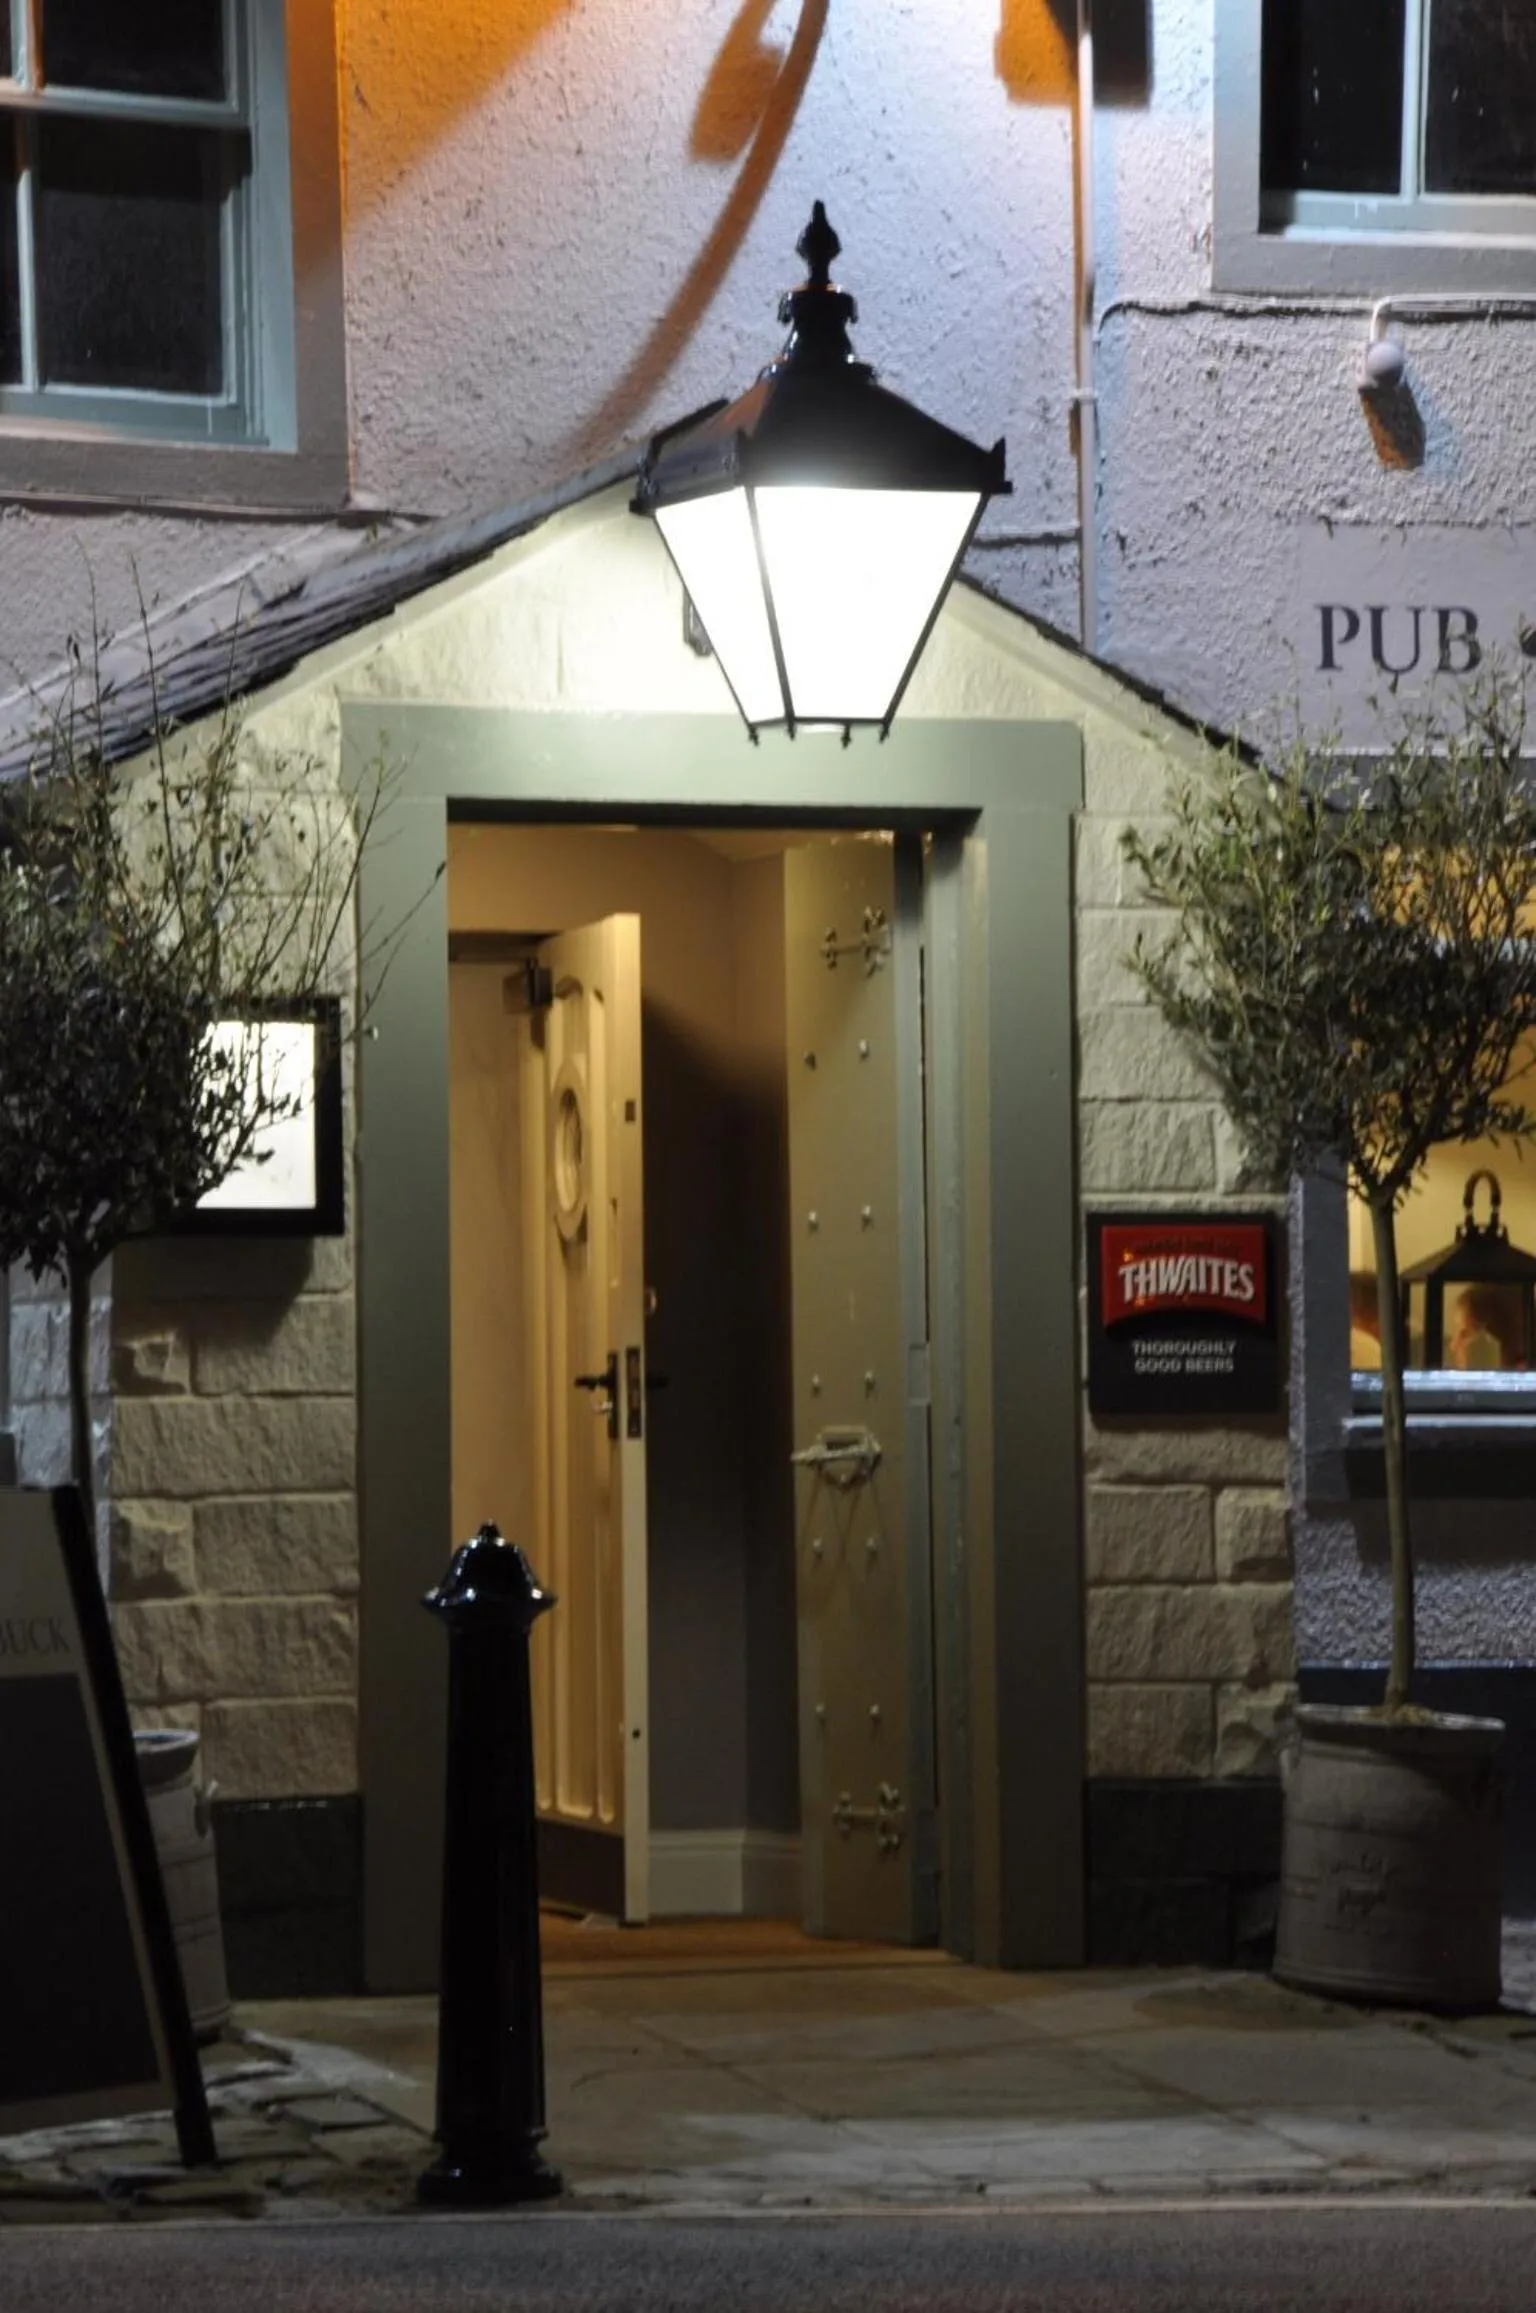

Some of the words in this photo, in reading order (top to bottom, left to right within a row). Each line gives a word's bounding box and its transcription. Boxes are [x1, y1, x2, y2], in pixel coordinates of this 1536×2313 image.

[1315, 604, 1482, 675] PUB
[1118, 1254, 1255, 1304] THWAITES
[1132, 1340, 1237, 1356] THOROUGHLY
[1134, 1357, 1181, 1373] GOOD
[1185, 1357, 1234, 1373] BEERS
